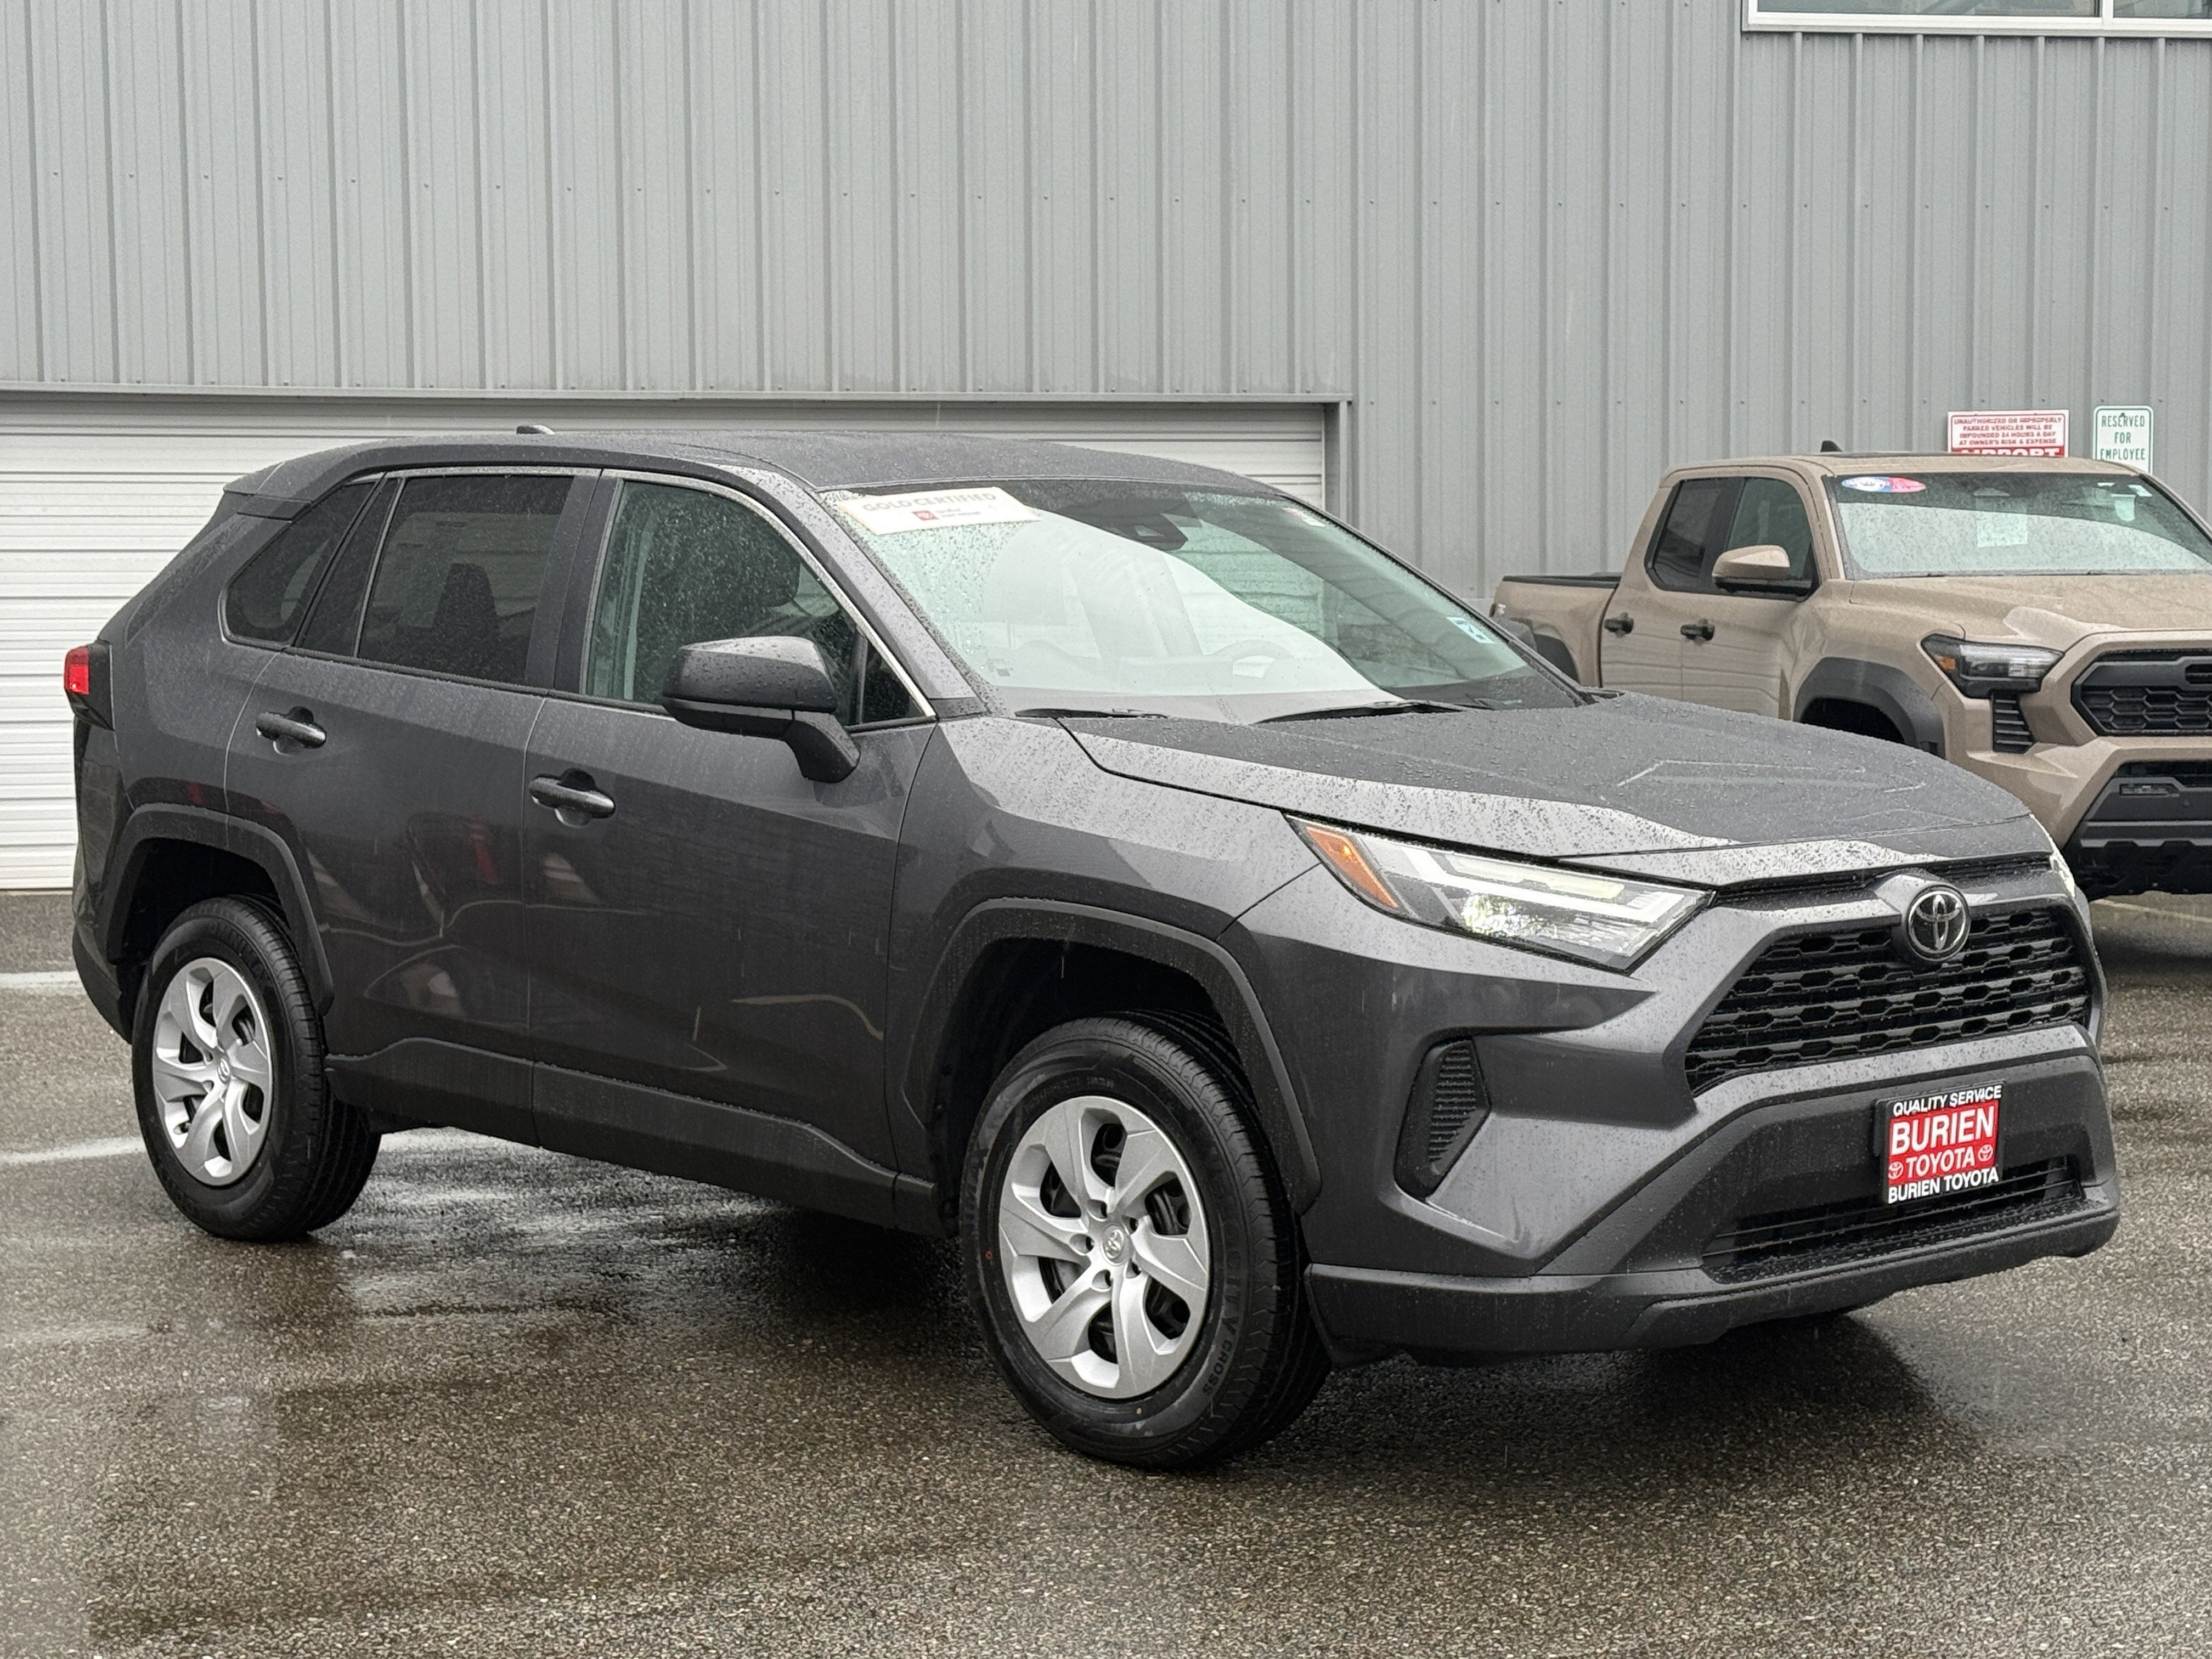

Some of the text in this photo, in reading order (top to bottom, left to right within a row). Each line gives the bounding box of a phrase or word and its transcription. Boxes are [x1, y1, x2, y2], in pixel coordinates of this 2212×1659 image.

[2101, 415, 2145, 428] RESERVED
[2114, 431, 2131, 444] FOR
[2100, 448, 2146, 461] EMPLOYEE
[862, 493, 997, 511] GOLD CERTIFIED
[1893, 1085, 2002, 1117] QUALITY SERVICE
[1891, 1105, 1995, 1156] BURIEN
[1906, 1146, 1976, 1178] TOYOTA
[1888, 1167, 1999, 1204] BURIEN TOYOTA
[1202, 1339, 1232, 1393] CROSS
